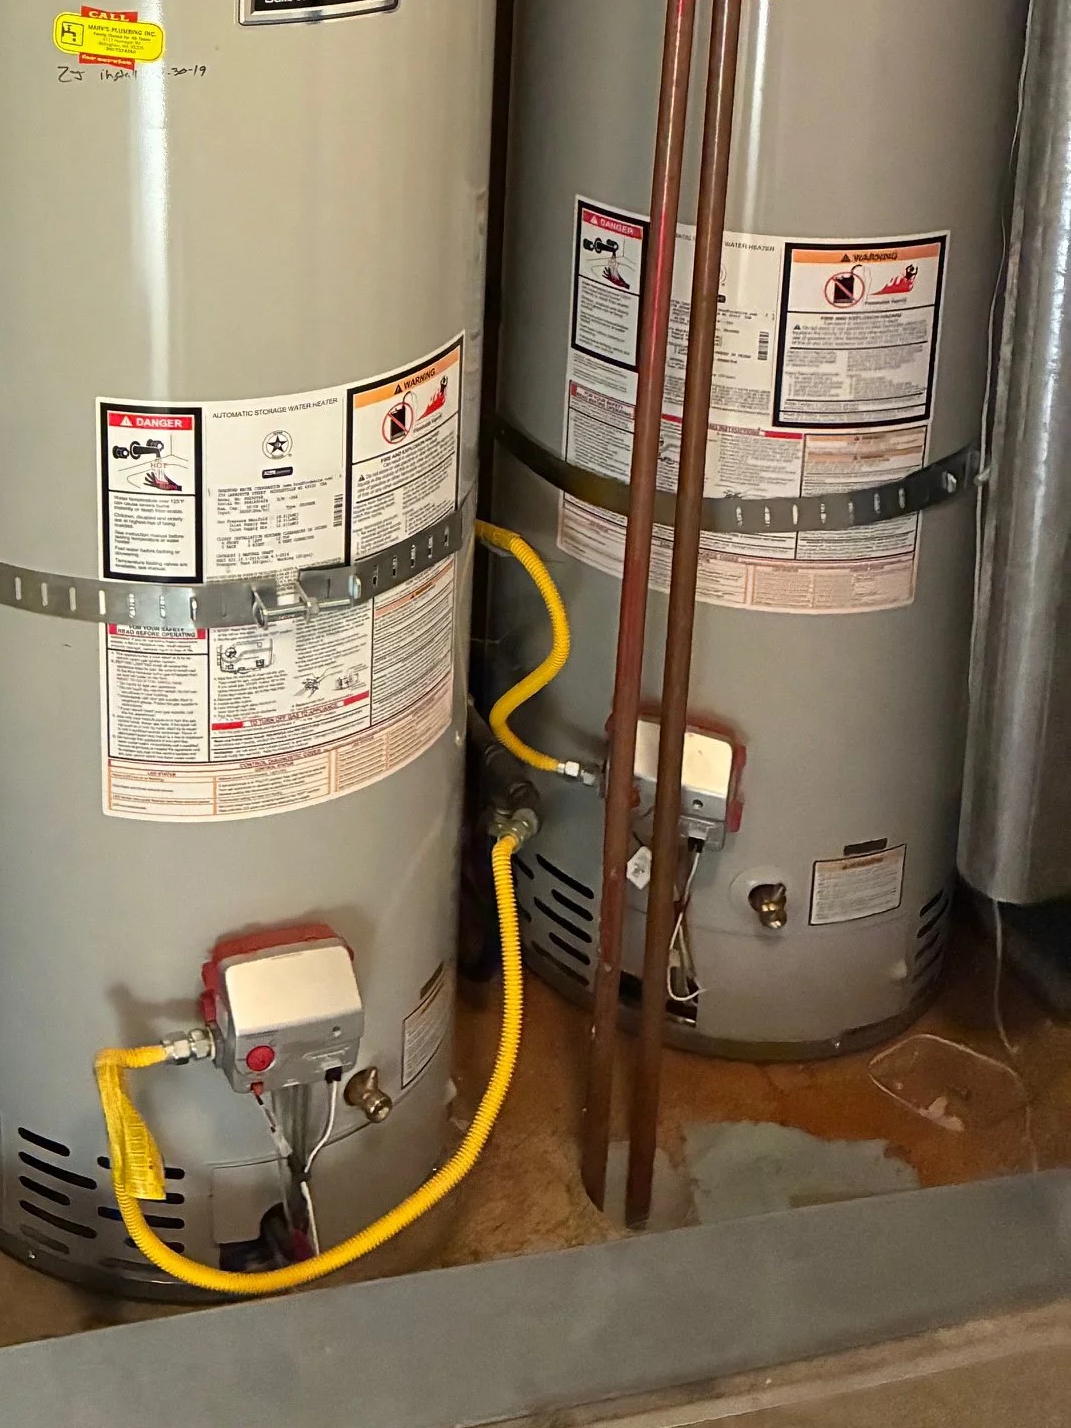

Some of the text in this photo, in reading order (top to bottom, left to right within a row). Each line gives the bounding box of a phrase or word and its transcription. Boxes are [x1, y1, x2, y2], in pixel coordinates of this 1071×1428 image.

[88, 10, 129, 22] CALL
[600, 220, 634, 235] DANGER
[404, 368, 436, 390] WARNING
[212, 397, 338, 419] AUTOMATIC STORAGE WATER HEATER
[136, 417, 182, 428] DANGER
